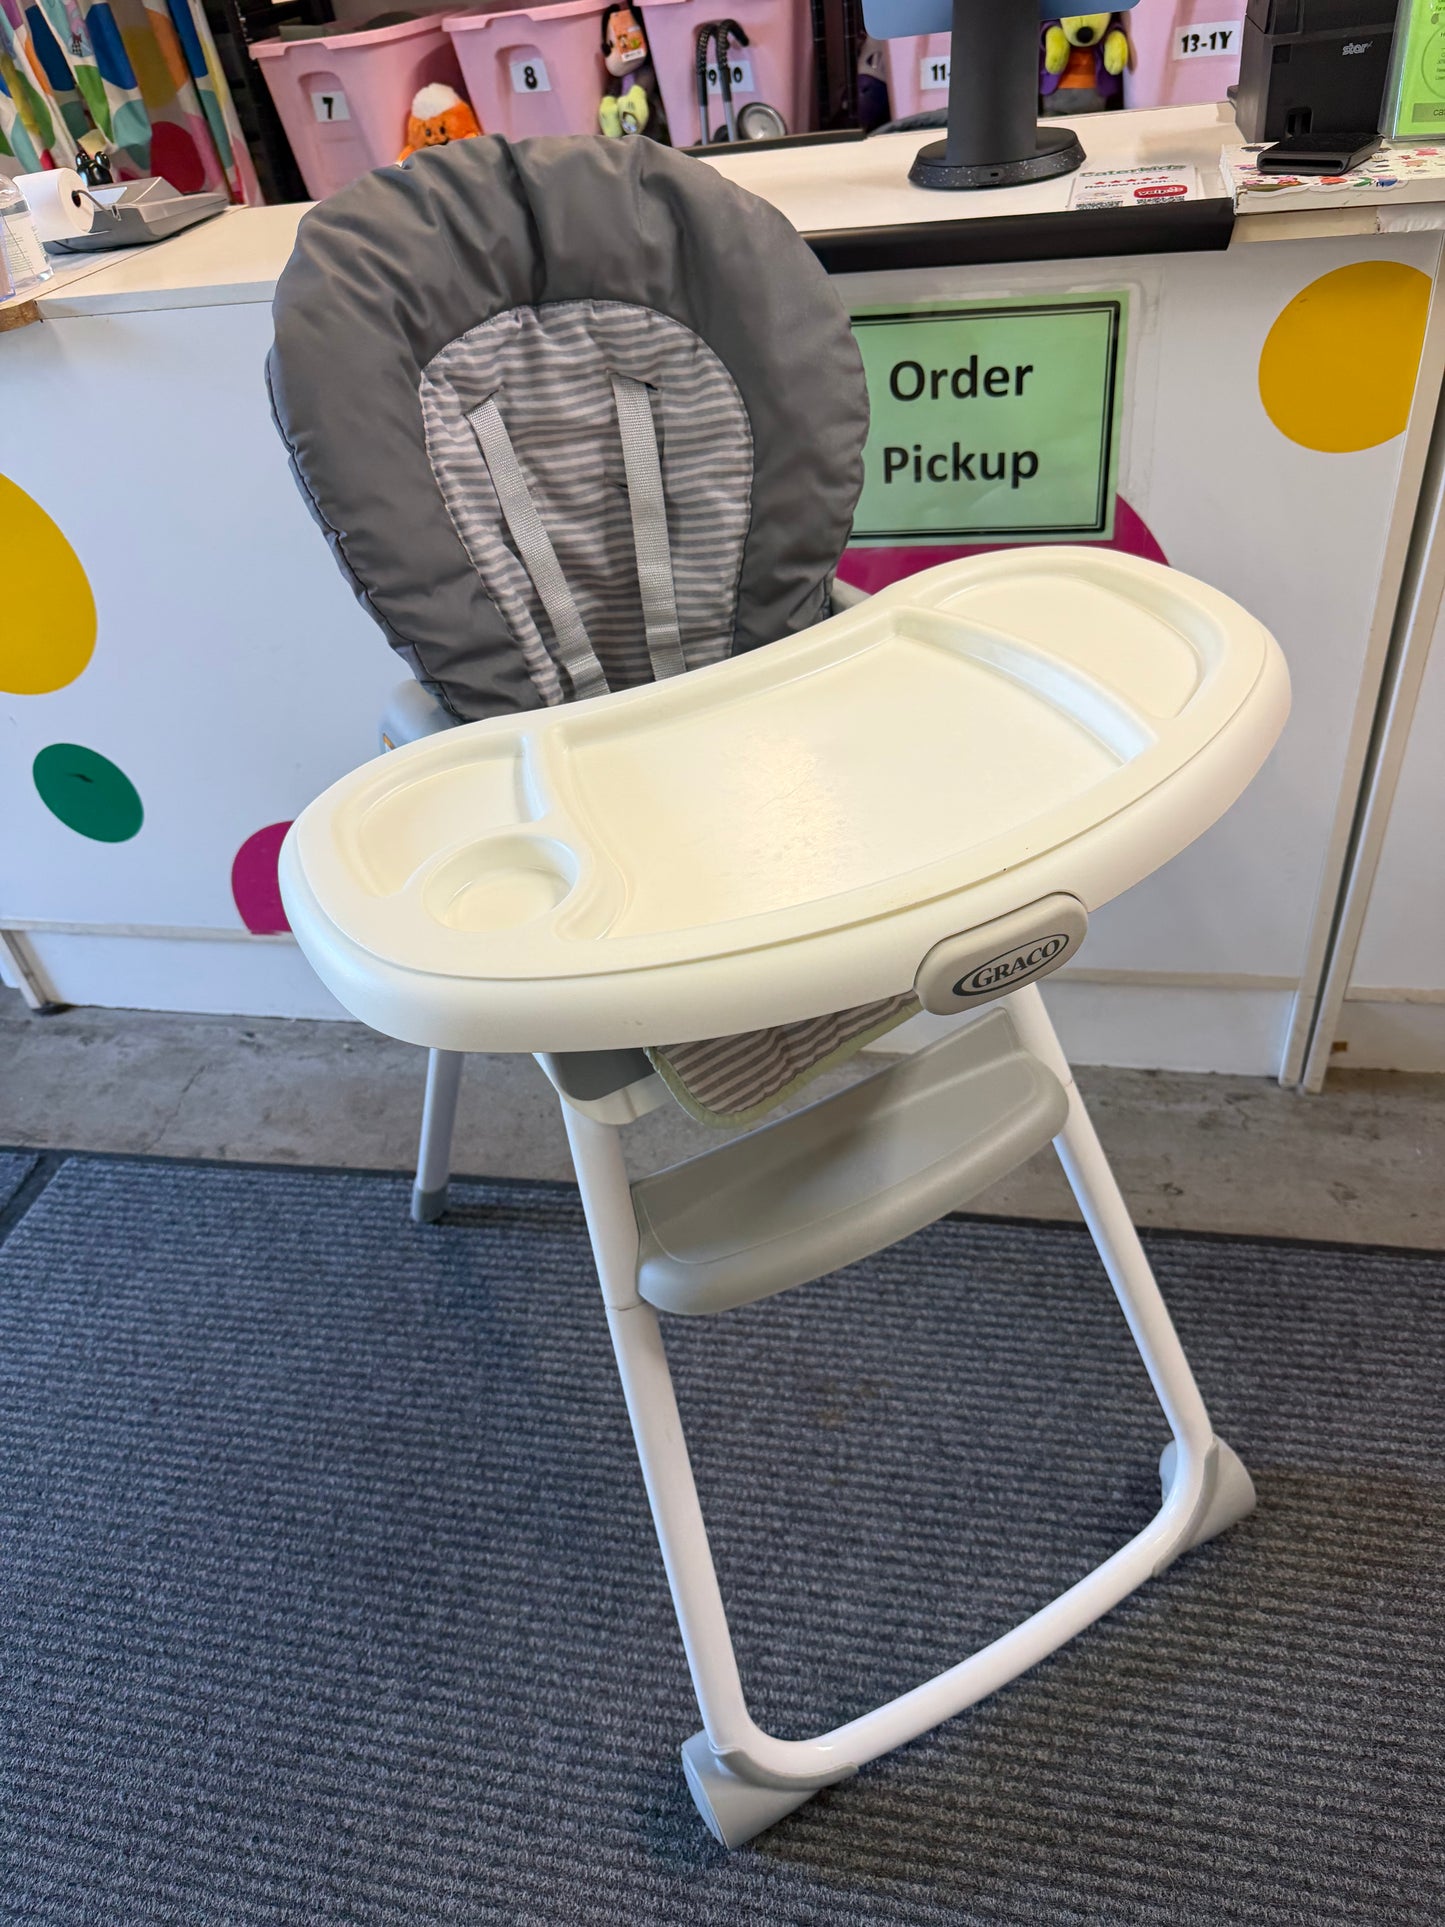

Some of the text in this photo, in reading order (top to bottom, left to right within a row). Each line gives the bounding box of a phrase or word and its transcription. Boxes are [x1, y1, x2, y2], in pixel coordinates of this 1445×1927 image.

[1181, 31, 1233, 53] 13-1Y
[1342, 42, 1370, 55] star
[523, 65, 538, 90] 8
[321, 96, 335, 120] 7
[889, 355, 1034, 401] Order
[883, 442, 1039, 489] Pickup
[971, 939, 1061, 989] GRACO
